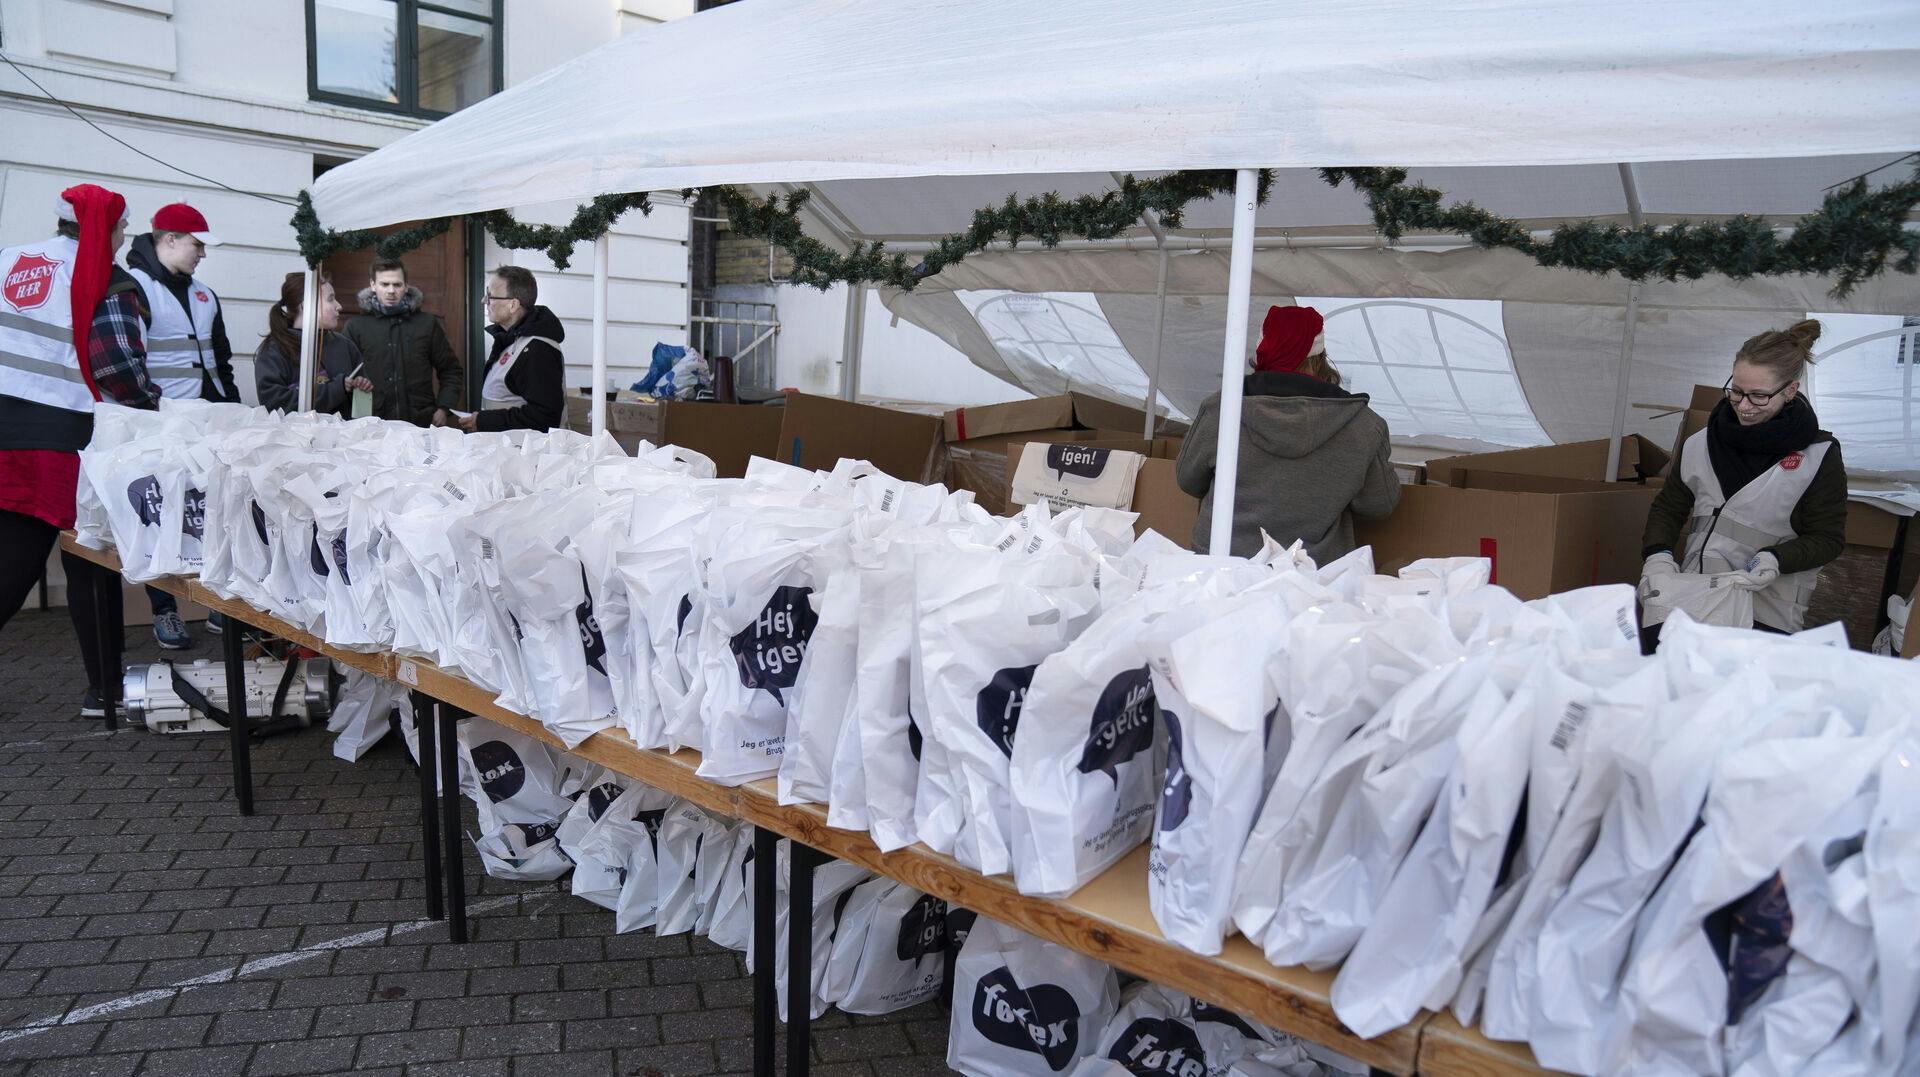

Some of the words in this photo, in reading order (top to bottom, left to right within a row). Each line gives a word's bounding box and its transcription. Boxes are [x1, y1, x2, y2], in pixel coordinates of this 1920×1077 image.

[1061, 447, 1097, 466] igen!
[185, 499, 206, 513] He
[756, 603, 794, 639] Hej
[740, 739, 756, 750] Jeg
